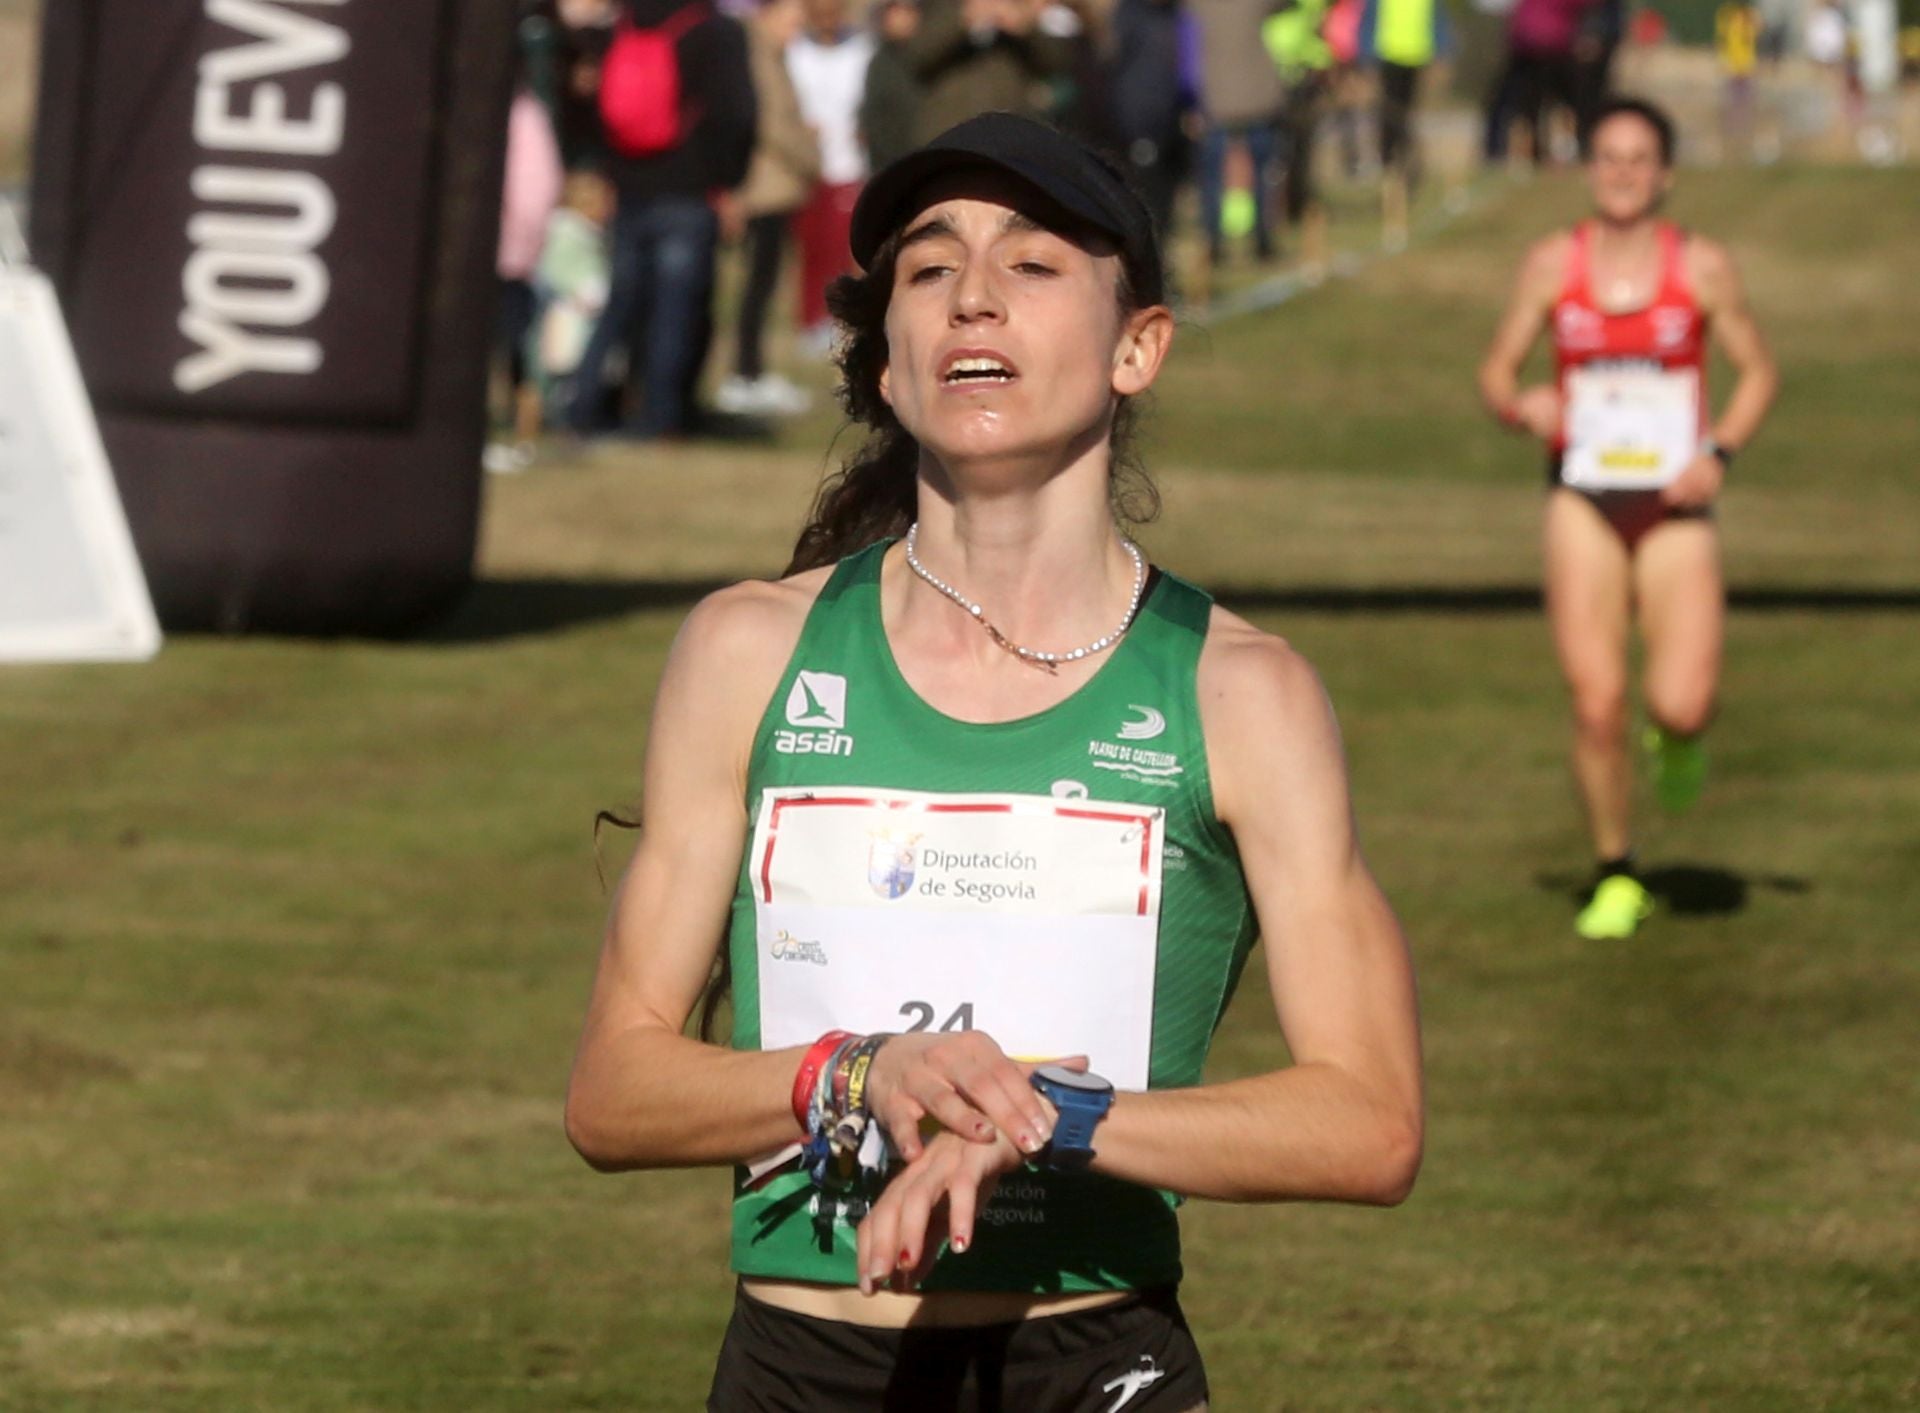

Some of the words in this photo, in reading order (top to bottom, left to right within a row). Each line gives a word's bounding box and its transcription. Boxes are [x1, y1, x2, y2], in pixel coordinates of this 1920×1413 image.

[173, 0, 350, 392] YOUEV
[923, 849, 1037, 872] Diputación
[919, 877, 946, 896] de
[953, 878, 1036, 903] Segovia
[899, 1000, 973, 1033] 24
[982, 1206, 1045, 1226] egovia
